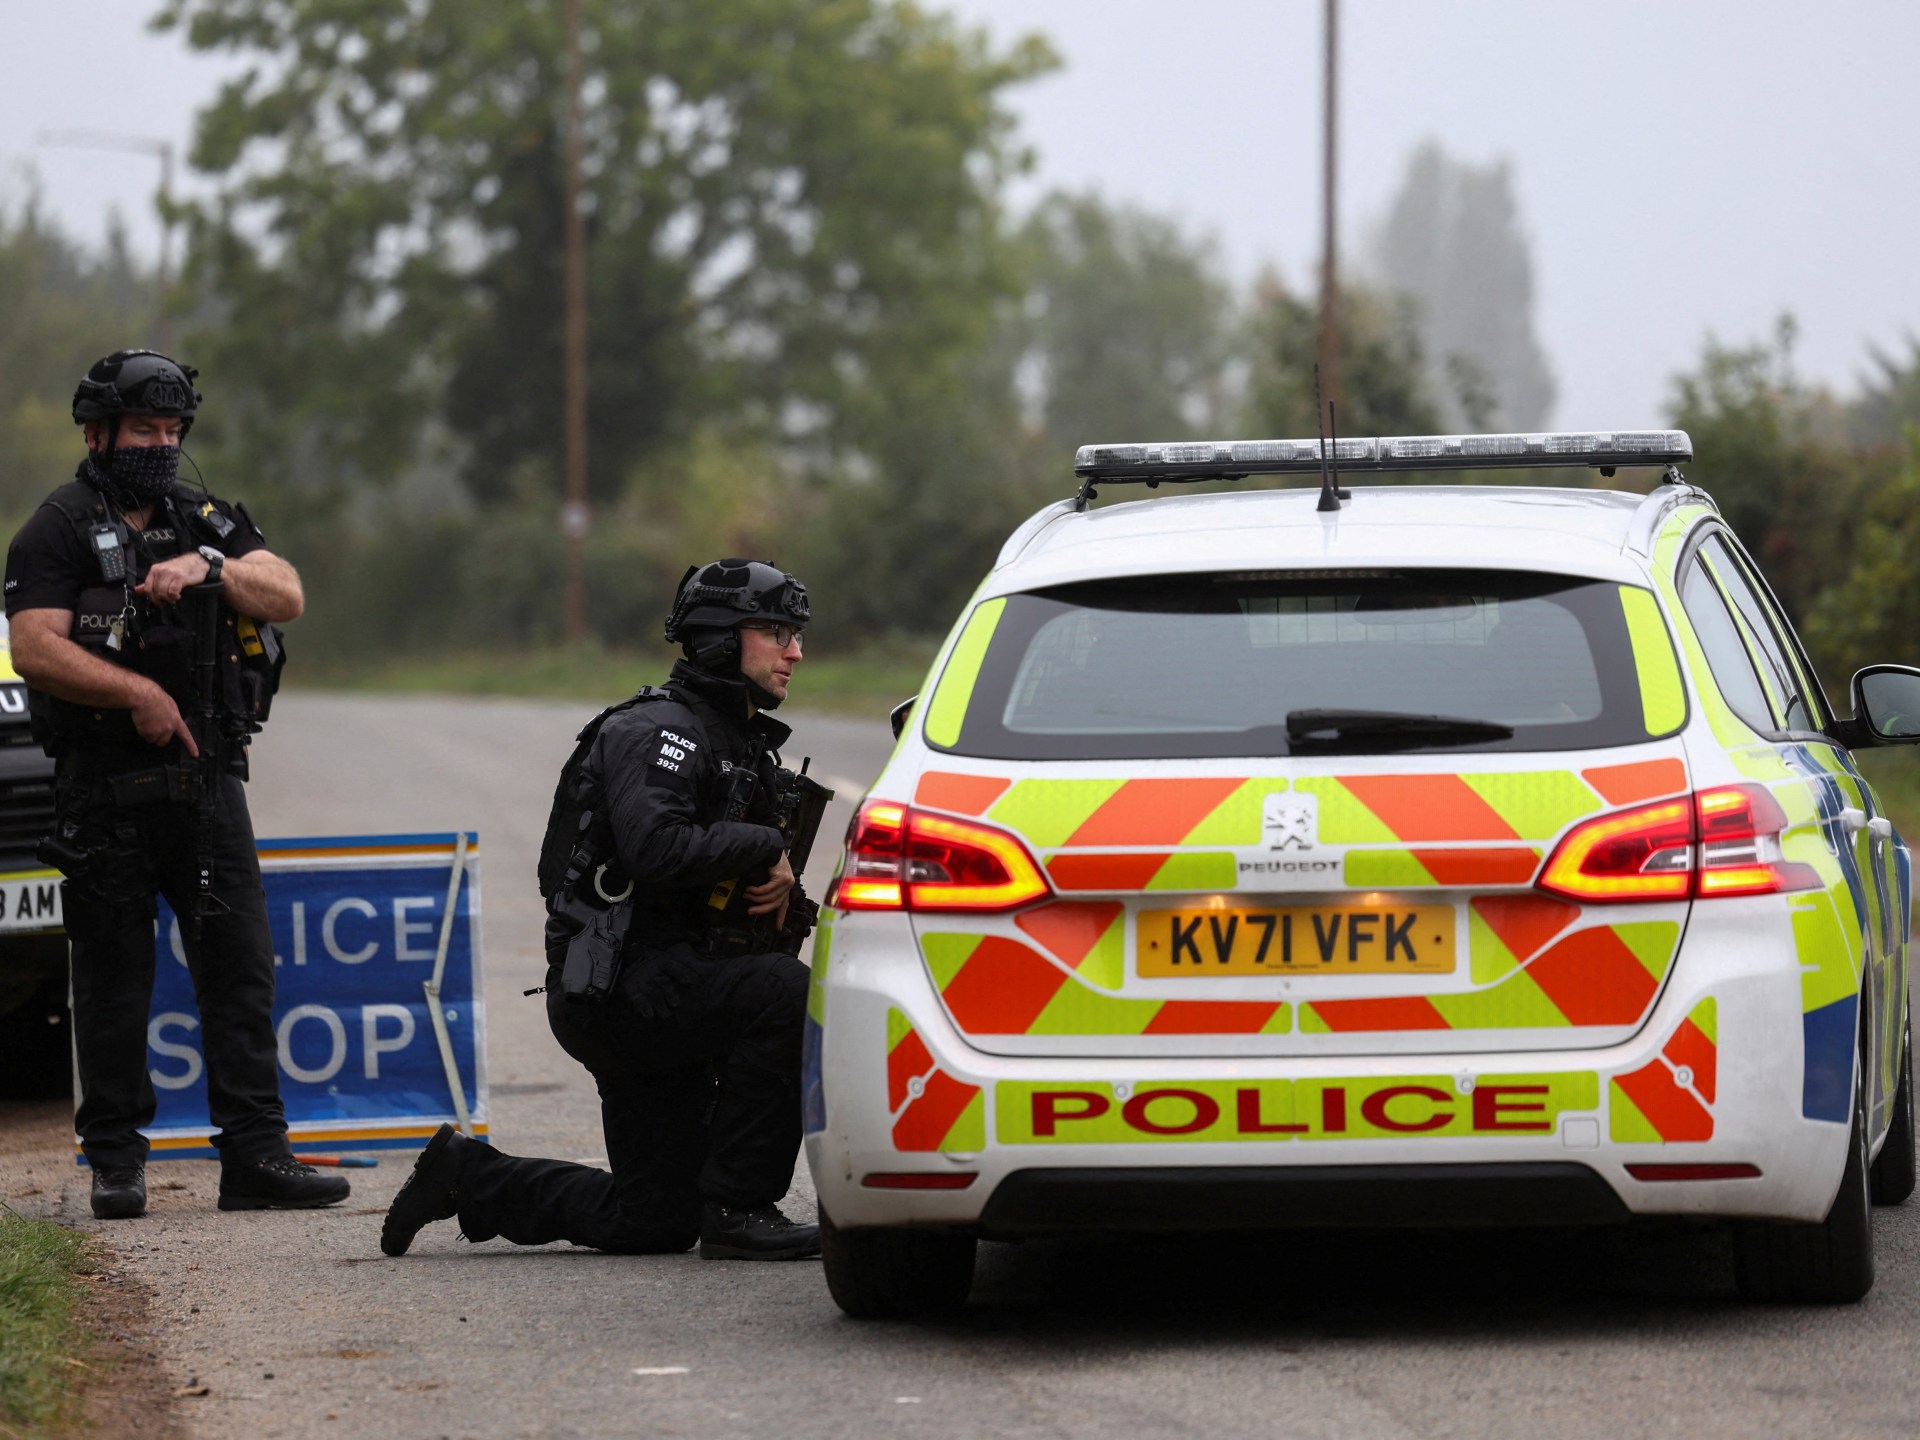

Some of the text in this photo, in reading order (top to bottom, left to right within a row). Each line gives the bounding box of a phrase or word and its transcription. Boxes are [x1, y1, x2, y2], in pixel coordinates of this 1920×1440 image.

[143, 529, 176, 542] POLIC
[80, 614, 119, 628] POLIC
[661, 730, 697, 751] POLICE
[660, 743, 685, 761] MD
[656, 758, 680, 772] 3921
[1239, 861, 1341, 873] PEUGEOT
[16, 883, 62, 920] AM
[1171, 912, 1417, 964] KV71 VFK
[147, 1004, 415, 1090] SOP
[1031, 1085, 1551, 1137] POLICE
